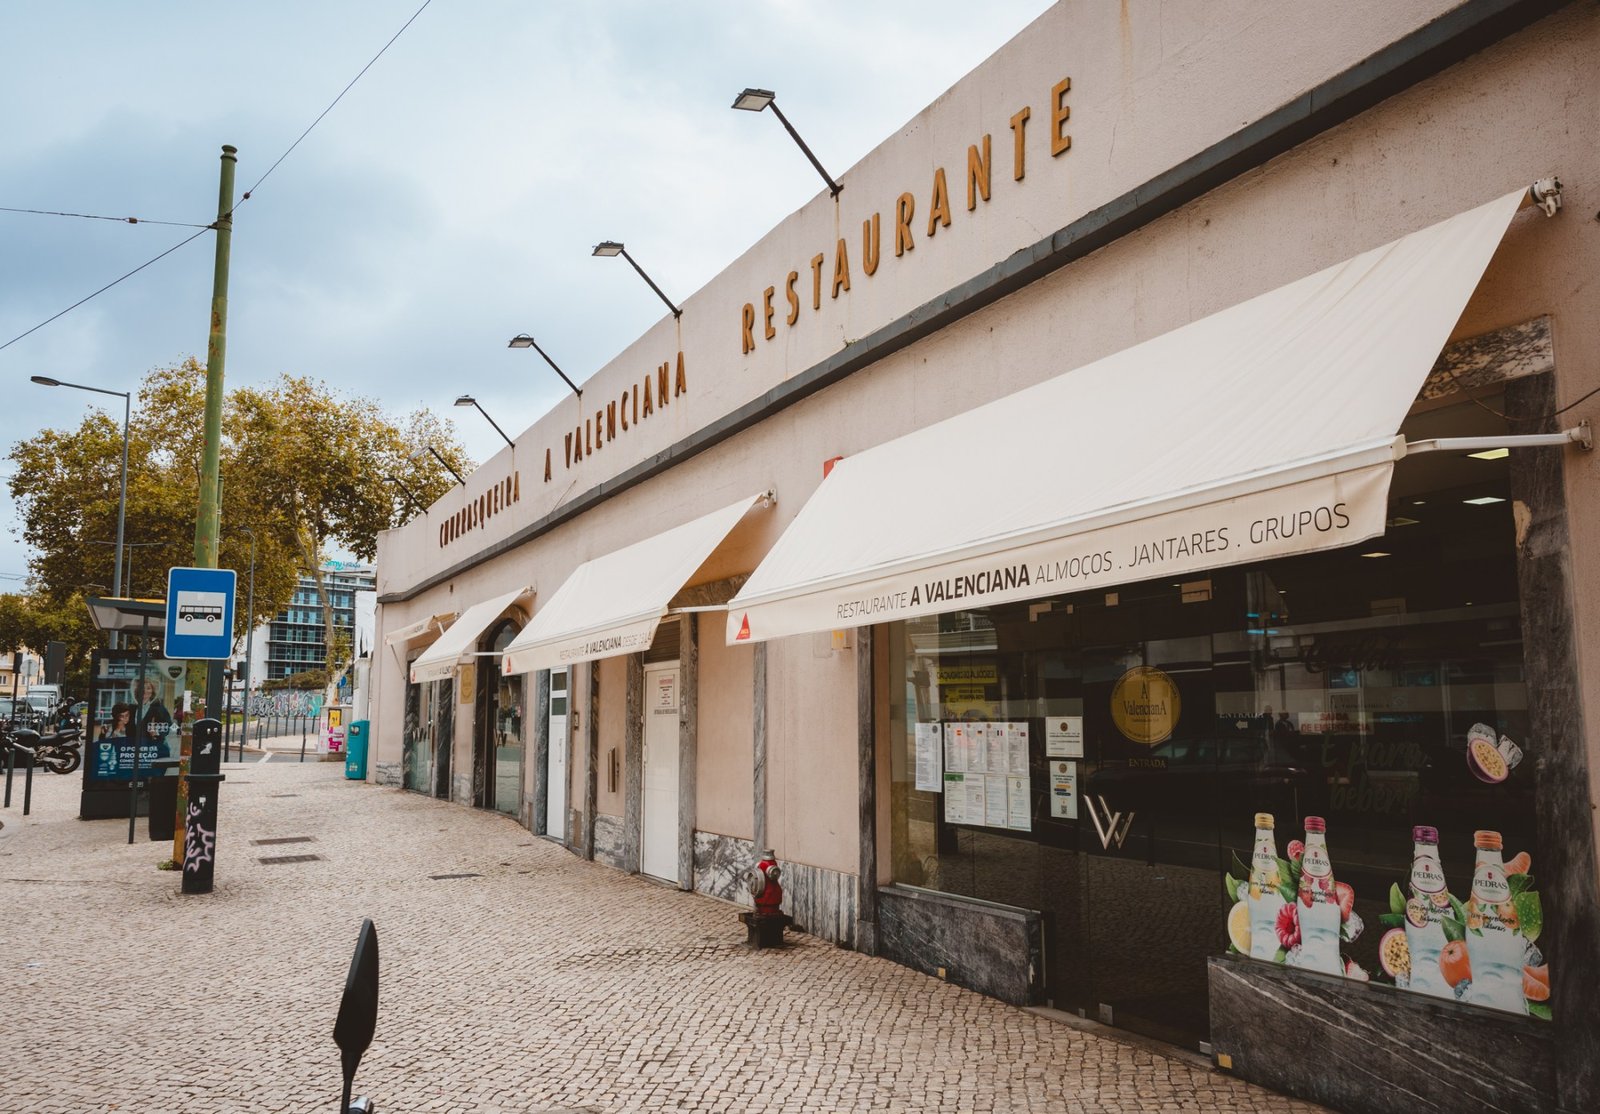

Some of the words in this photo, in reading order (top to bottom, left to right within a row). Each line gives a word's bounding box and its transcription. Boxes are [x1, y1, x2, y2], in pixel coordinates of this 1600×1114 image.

[440, 471, 520, 549] CHURRASQUEIRA
[544, 448, 552, 482] A
[565, 351, 687, 469] VALENCIANA
[742, 77, 1072, 354] RESTAURANTE
[837, 592, 907, 619] RESTAURANTE
[910, 586, 921, 606] A
[925, 564, 1031, 603] VALENCIANA
[1035, 551, 1113, 584] ALMOÇOS
[1128, 527, 1229, 567] JANTARES
[1250, 503, 1350, 544] GRUPOS
[590, 635, 622, 653] VALENCIANA
[1301, 723, 1313, 732] DE
[1129, 758, 1166, 769] ENTRADA
[1413, 871, 1443, 881] PEDRAS
[1474, 880, 1508, 890] PEDRAS
